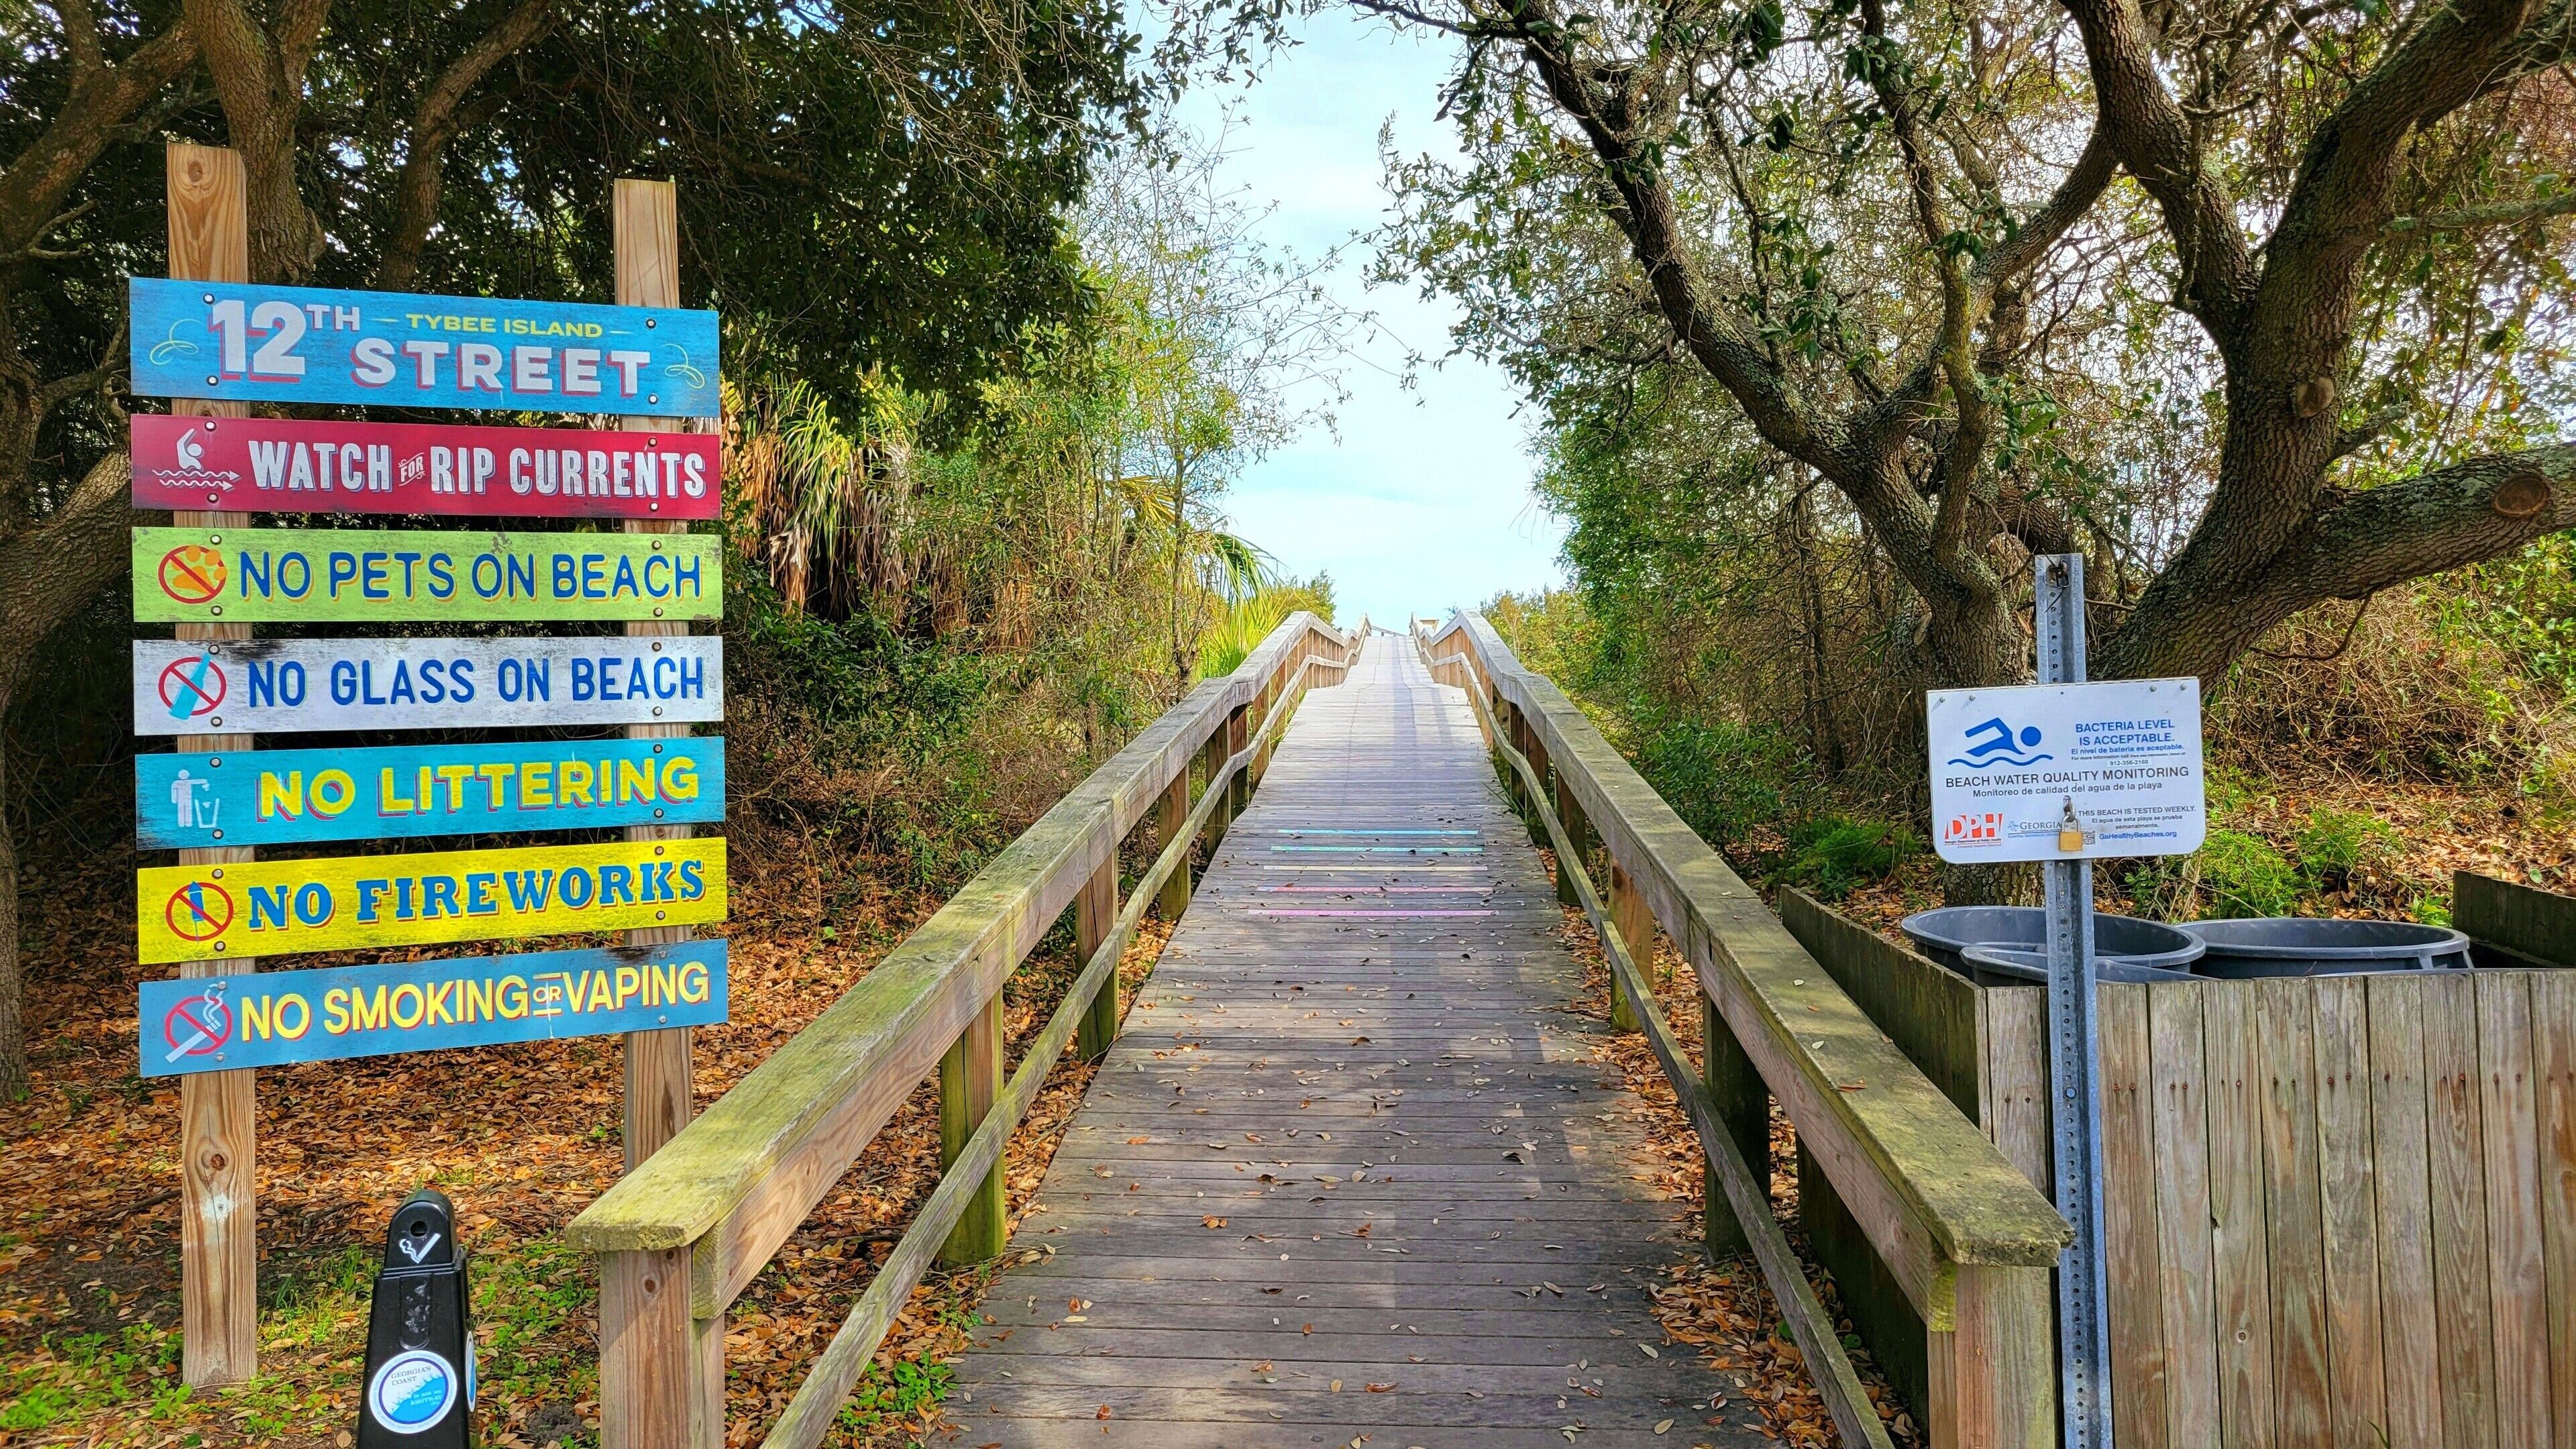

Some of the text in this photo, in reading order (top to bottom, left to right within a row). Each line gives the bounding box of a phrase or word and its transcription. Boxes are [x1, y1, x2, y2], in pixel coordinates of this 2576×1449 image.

[405, 313, 602, 338] TYBEE ISLAND
[209, 299, 651, 398] 12TH STREET
[248, 440, 707, 498] WATCH FOR RIP CURRENTS
[239, 550, 702, 601] NO PETS ON BEACH
[248, 655, 705, 708] NO GLASS ON BEACH
[2075, 718, 2176, 733] BACTERIA LEVEL
[2079, 732, 2176, 746] IS ACCEPTABLE.
[256, 755, 700, 822] NO LITTERING
[1945, 766, 2189, 788] BEACH WATER QUALITY MONITORING
[1973, 789, 2019, 797] Monitoreo
[2035, 786, 2069, 794] calidad
[2071, 784, 2085, 792] del
[2088, 785, 2110, 793] agua
[2127, 782, 2135, 790] la
[2138, 782, 2162, 790] playa
[2164, 805, 2196, 813] WEEKLY.
[2099, 830, 2177, 840] GaHealthyBeaches.org
[248, 859, 706, 931] NO FIREWORKS
[240, 960, 710, 1042] NO SMOKING OR VAPING
[390, 1366, 431, 1379] GEORGIA'S
[392, 1375, 417, 1386] COAST
